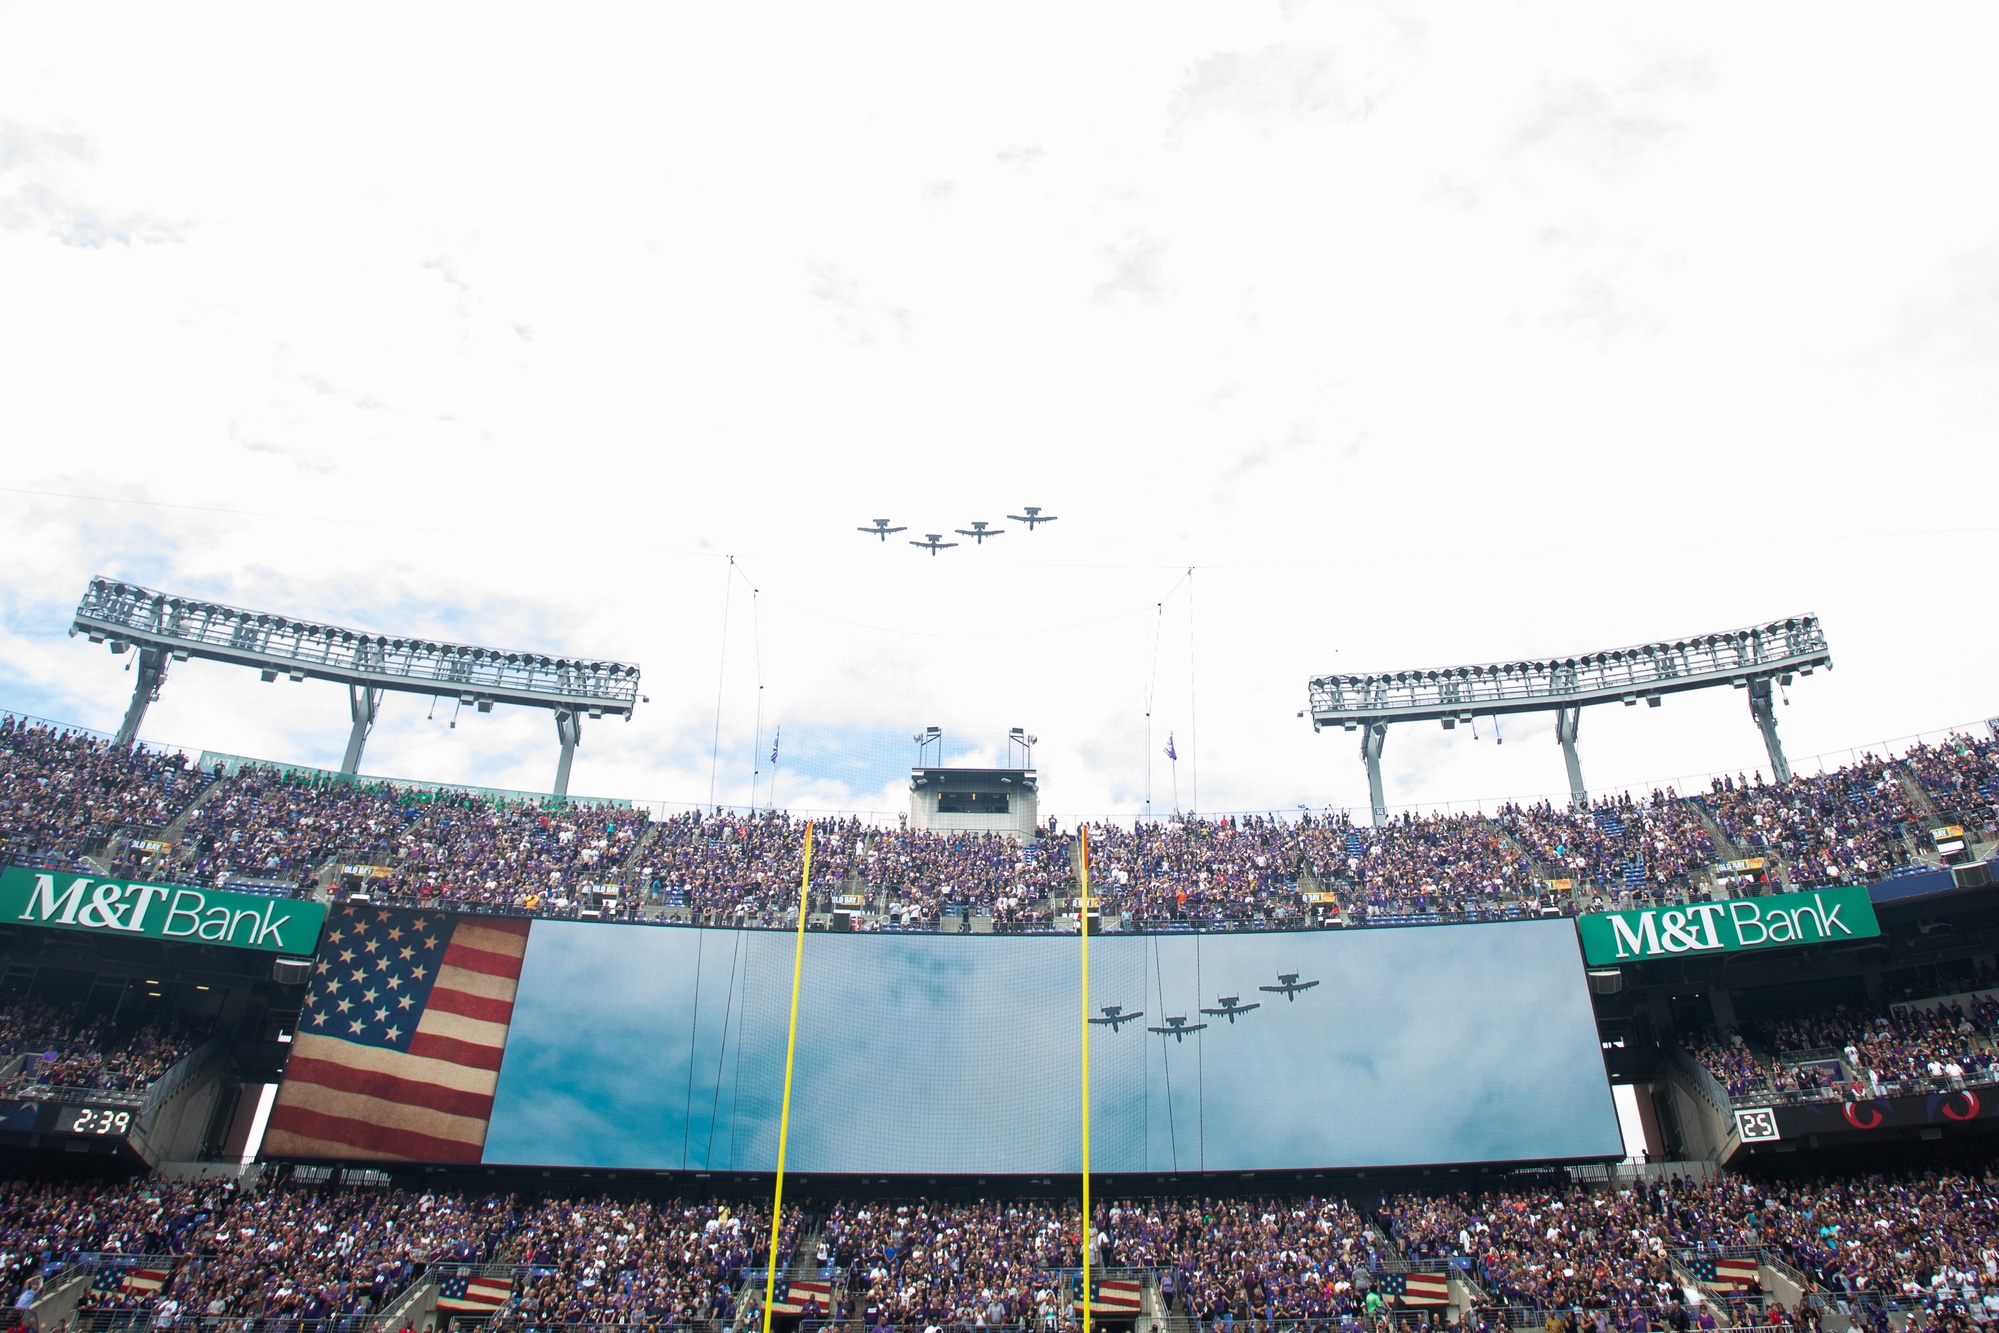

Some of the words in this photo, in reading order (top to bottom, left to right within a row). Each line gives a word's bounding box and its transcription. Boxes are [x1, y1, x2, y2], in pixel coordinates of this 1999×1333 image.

[146, 842, 162, 851] BAY
[344, 865, 358, 874] OLD
[592, 885, 606, 893] OLD
[606, 885, 620, 894] BAY
[831, 896, 844, 904] OLD
[844, 896, 857, 904] BAY
[18, 873, 169, 932] M&T
[162, 889, 291, 947] Bank
[1606, 904, 1725, 958] M&T
[1729, 893, 1852, 946] Bank
[73, 1108, 130, 1134] 2:39
[1743, 1113, 1772, 1136] 25
[950, 1243, 958, 1251] 20
[1955, 1305, 1966, 1314] 52
